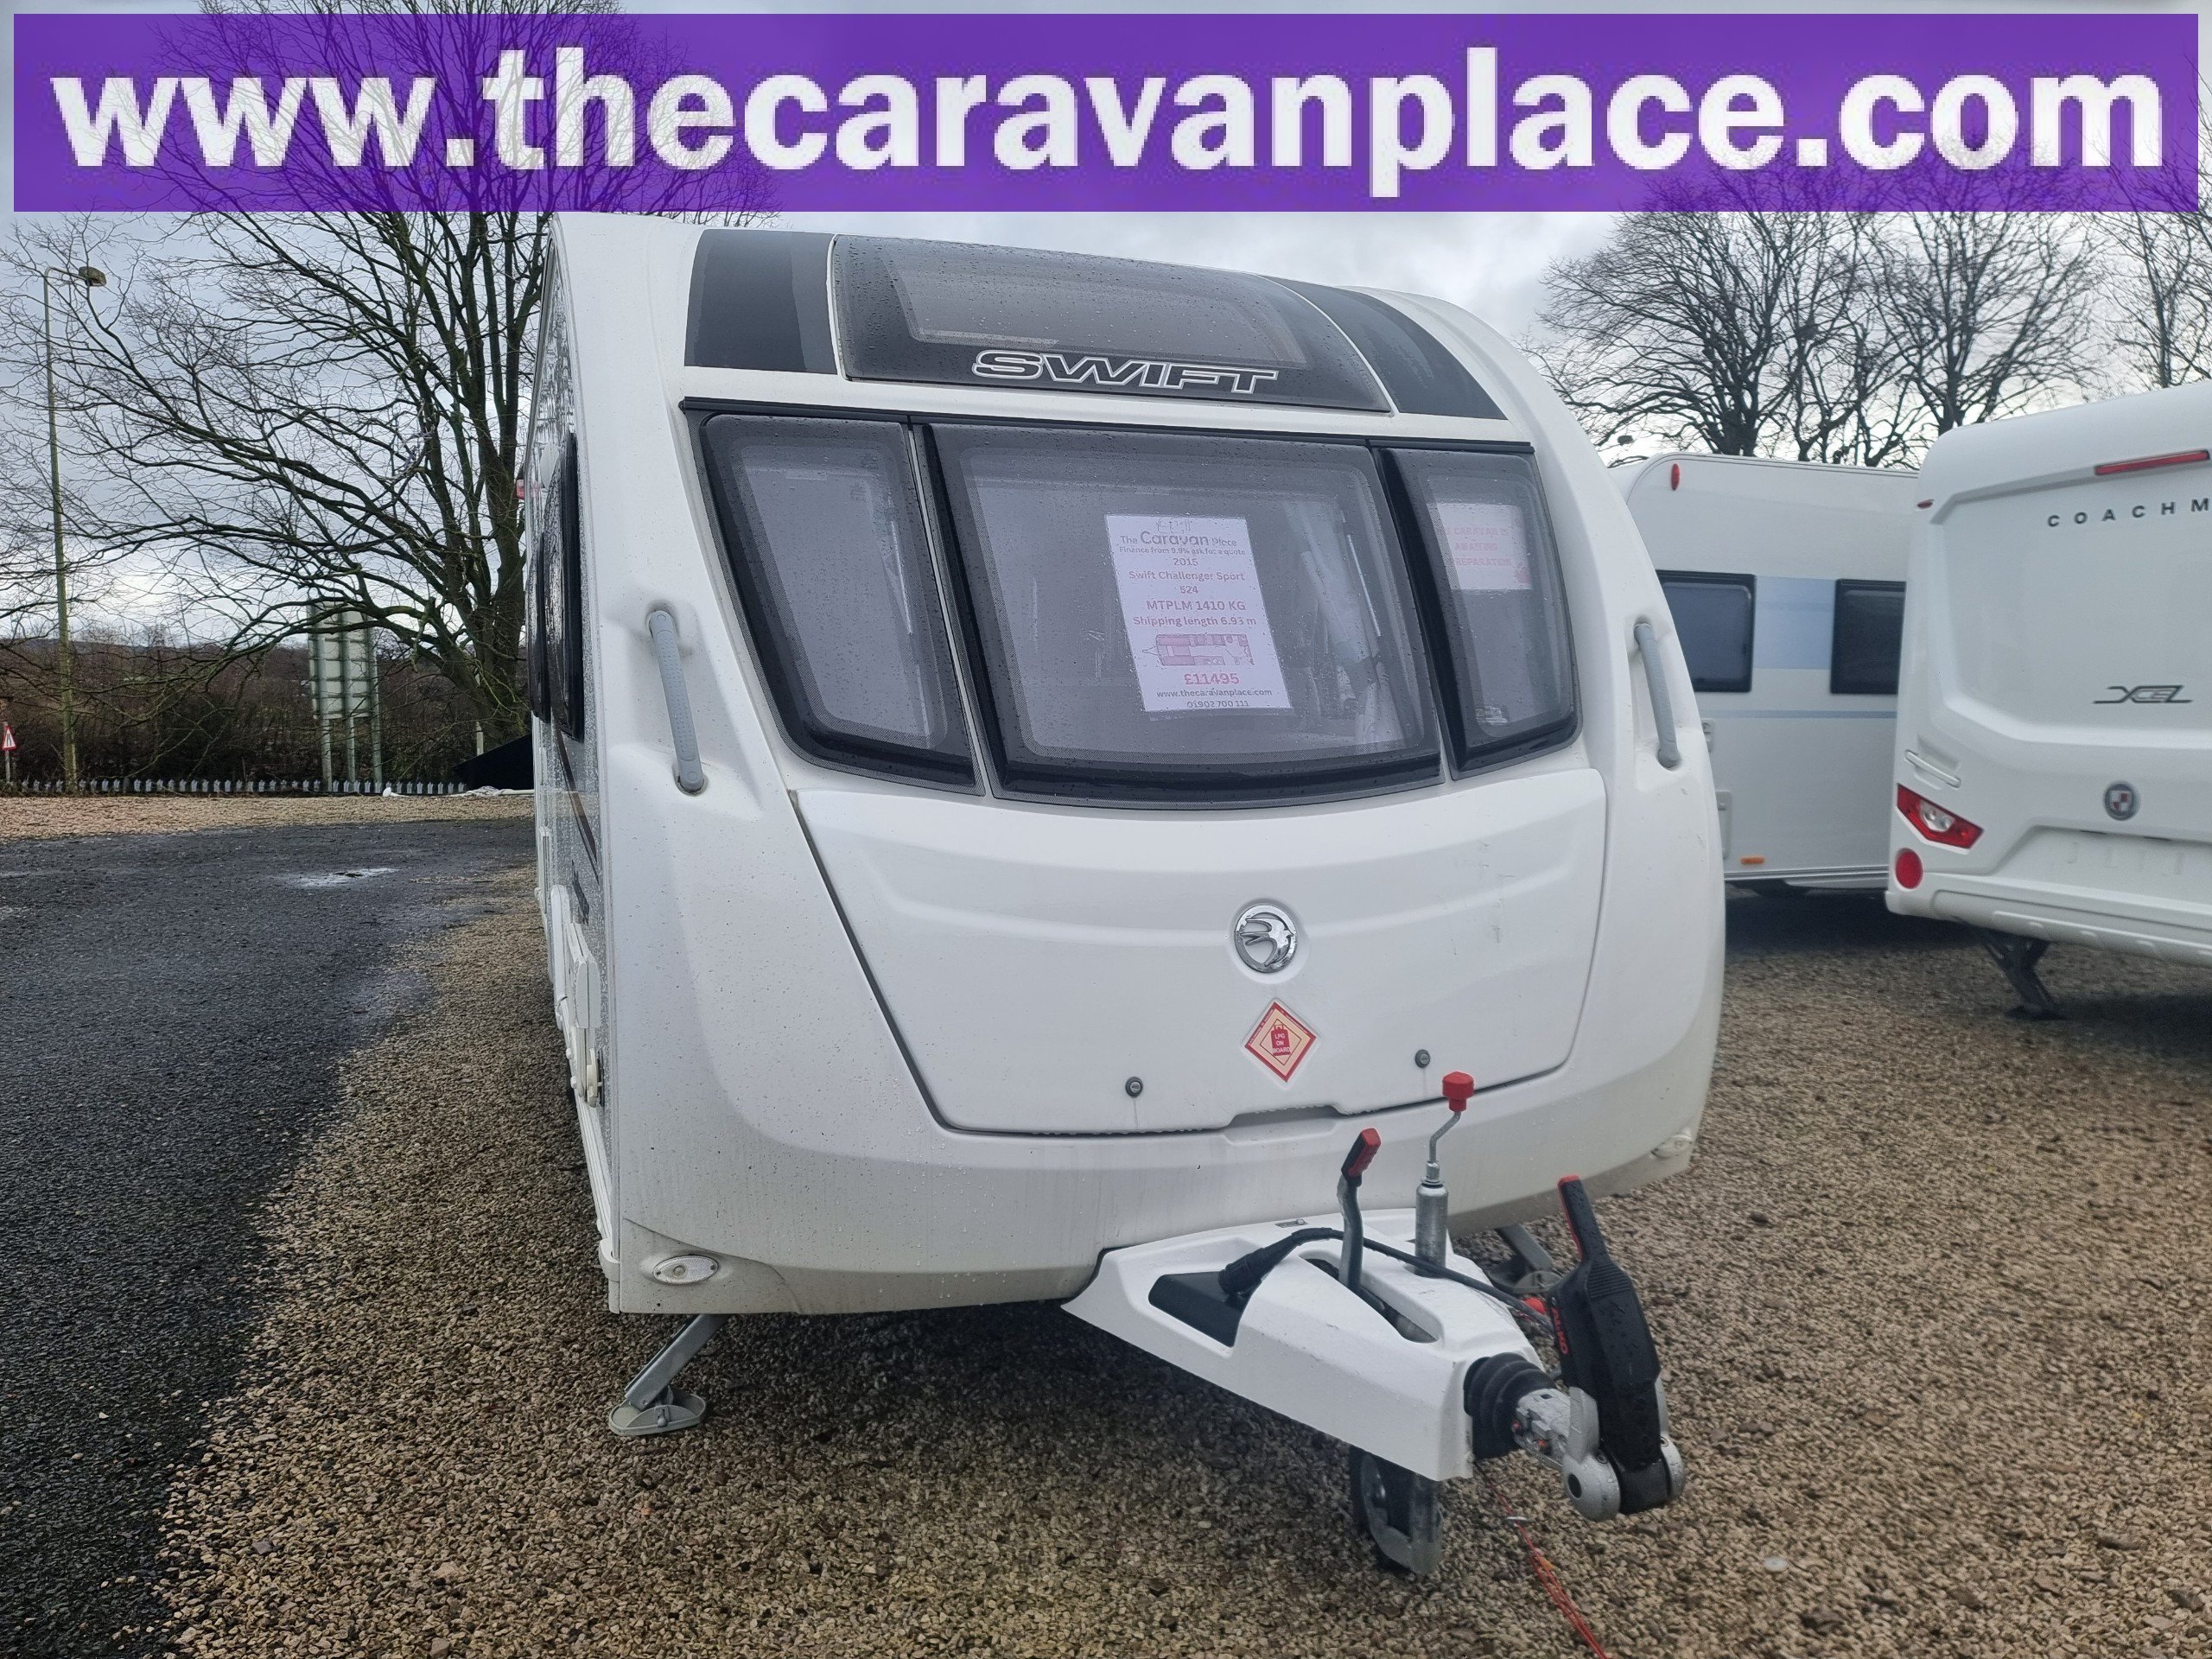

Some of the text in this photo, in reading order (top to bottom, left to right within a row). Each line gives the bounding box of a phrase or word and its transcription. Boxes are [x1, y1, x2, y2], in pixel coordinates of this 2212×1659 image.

[971, 349, 1280, 394] SWIFT
[1120, 535, 1138, 544] The
[1140, 531, 1210, 546] Caravan
[1173, 557, 1198, 566] 2015
[1451, 557, 1512, 566] REPARATION
[1128, 570, 1245, 582] Swift Challenger Sport
[1179, 585, 1198, 594] 524
[1146, 600, 1246, 610] MTPLM 1410 KG
[1133, 616, 1182, 627] Shipping
[1184, 616, 1218, 627] length
[1246, 617, 1256, 626] m
[1184, 672, 1240, 685] £11495
[1156, 688, 1273, 698] www.thecaravanplace.com
